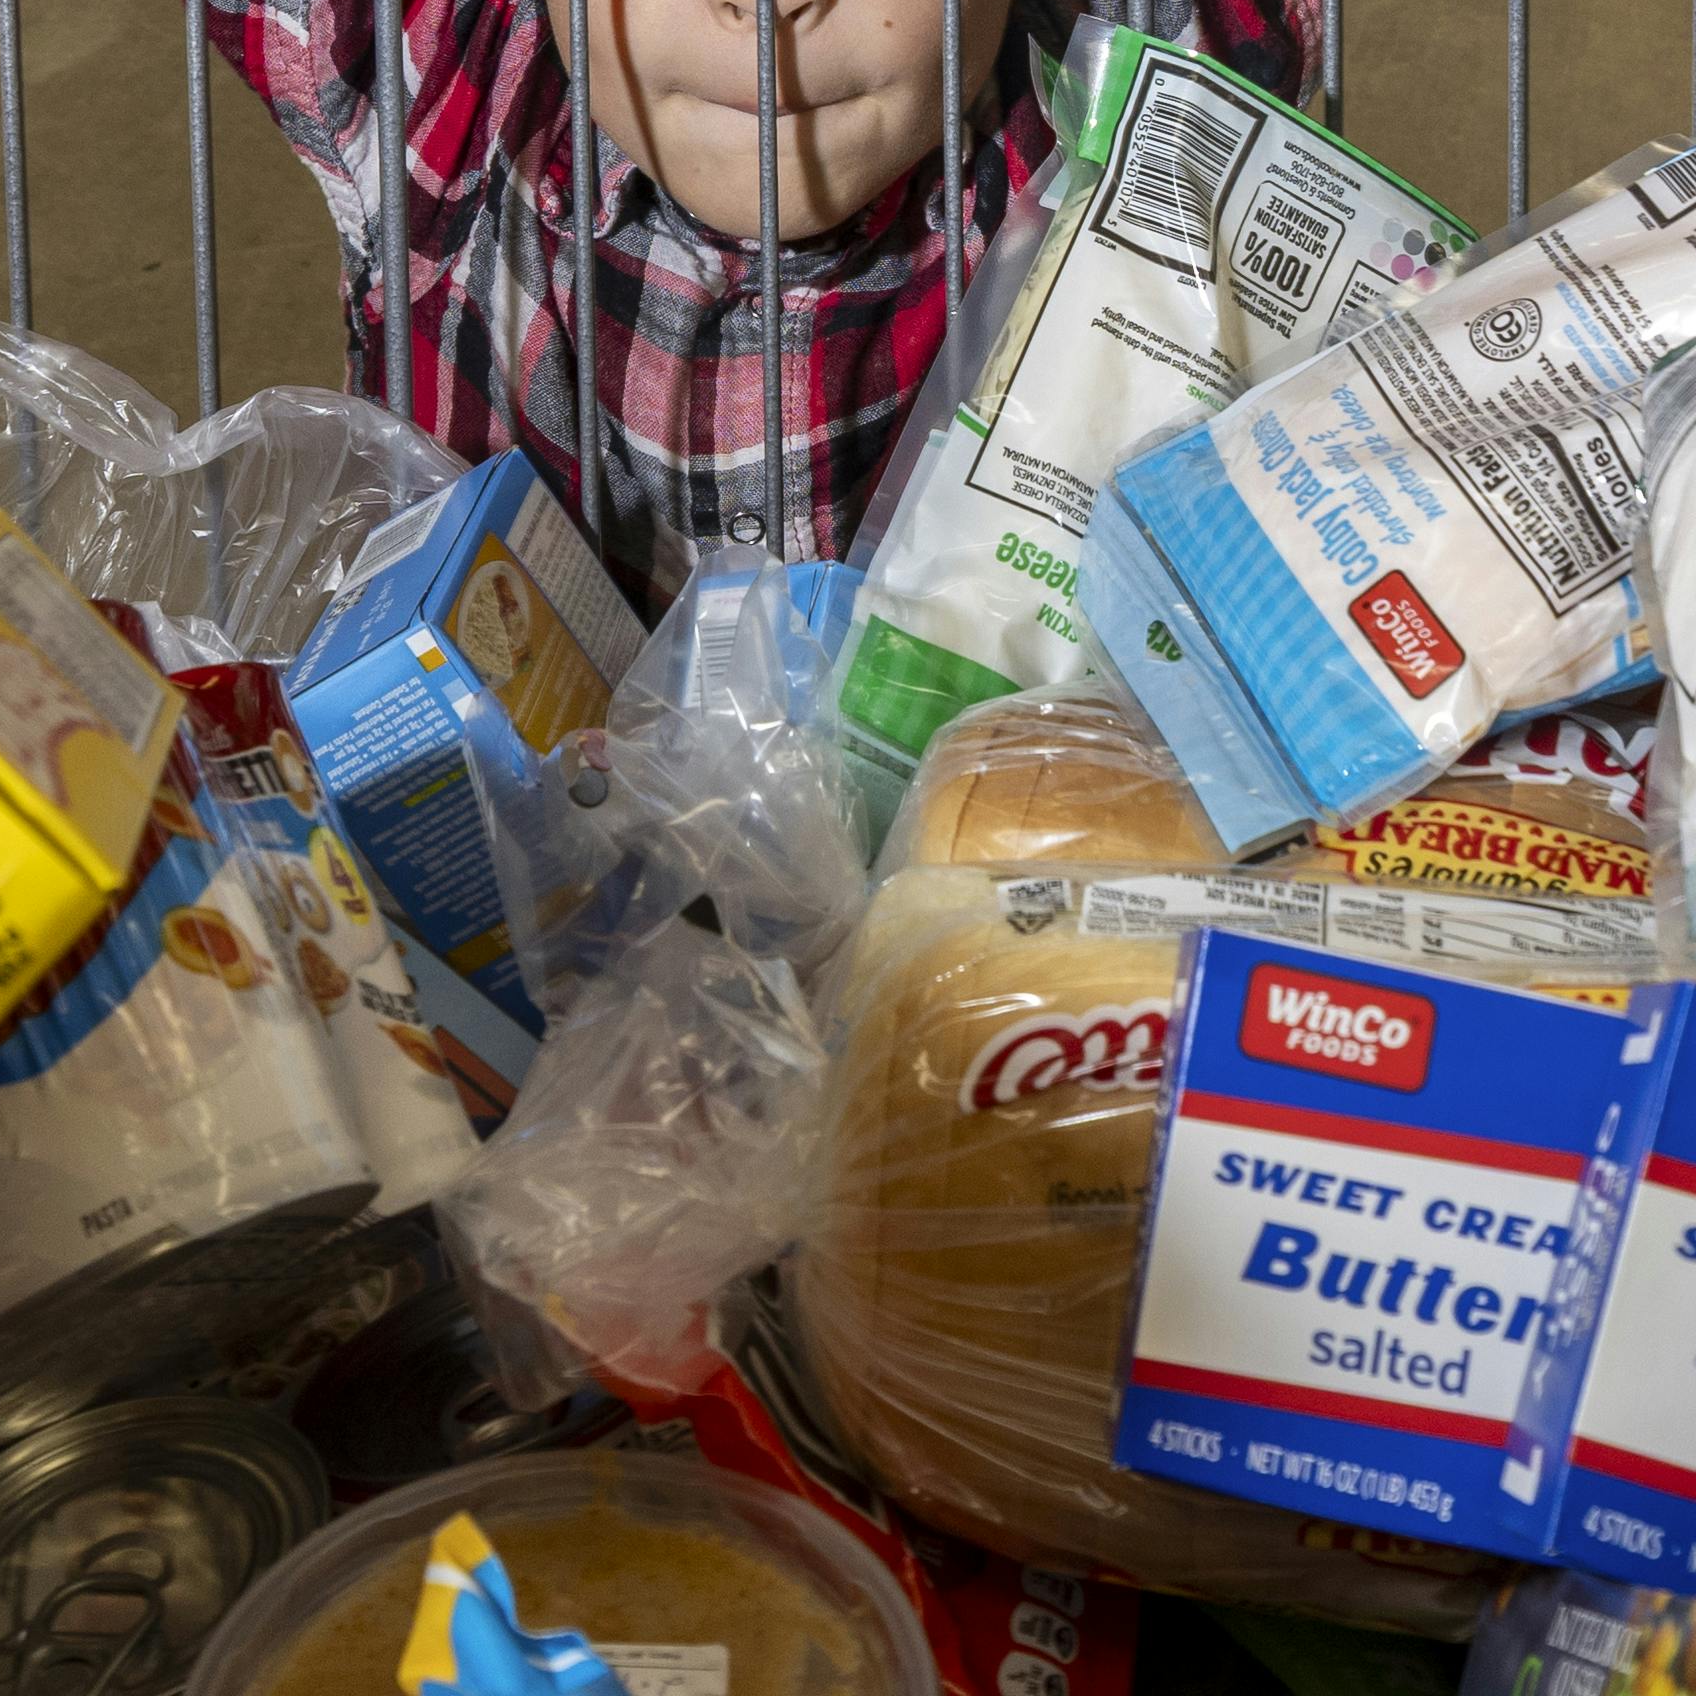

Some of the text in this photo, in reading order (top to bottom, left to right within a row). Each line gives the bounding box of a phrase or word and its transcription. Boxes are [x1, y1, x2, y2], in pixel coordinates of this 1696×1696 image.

[1114, 103, 1155, 207] 70552 40107
[1282, 139, 1362, 192] www.wincofoods.com
[1288, 159, 1345, 198] 800-824-1706
[1264, 160, 1357, 220] Comments & Questions?
[1265, 194, 1329, 241] GUARANTEE
[1238, 229, 1314, 301] 100%
[1252, 206, 1327, 259] SATISFACTION
[1098, 304, 1221, 375] quantity needed and reseal tightly.
[1257, 295, 1297, 326] Low Price
[1089, 315, 1207, 381] packages until the date stamped
[1001, 446, 1096, 497] NATAMYCIN (A NATURAL
[1011, 480, 1044, 501] CHEESE
[1236, 407, 1390, 590] Colby Jack Cheese
[1301, 419, 1417, 556] shredded colby &
[1378, 447, 1449, 527] monterey
[1460, 439, 1584, 588] Nutrition Facts
[1517, 456, 1603, 571] About 8 servings per
[1533, 454, 1617, 564] Serving size 1/4
[1362, 593, 1440, 681] WinCo
[1393, 595, 1441, 650] FOODS
[311, 683, 427, 761] serving. See Nutrition Facts Panel
[331, 695, 435, 762] Fat reduced to 2g from per
[350, 675, 421, 723] for Sodium Content.
[394, 723, 410, 738] per
[325, 752, 363, 781] Saturated
[365, 731, 398, 757] serving.
[1267, 983, 1413, 1050] WinCo
[1286, 1029, 1379, 1067] FOODS
[1215, 1151, 1572, 1259] SWEET CREA
[1241, 1220, 1546, 1344] Butter
[1308, 1328, 1472, 1398] salted
[1148, 1418, 1407, 1509] 4 STICKS NET WT 16 OZ (1 LB)
[1582, 1506, 1601, 1538] 4
[1600, 1507, 1666, 1561] STICKS
